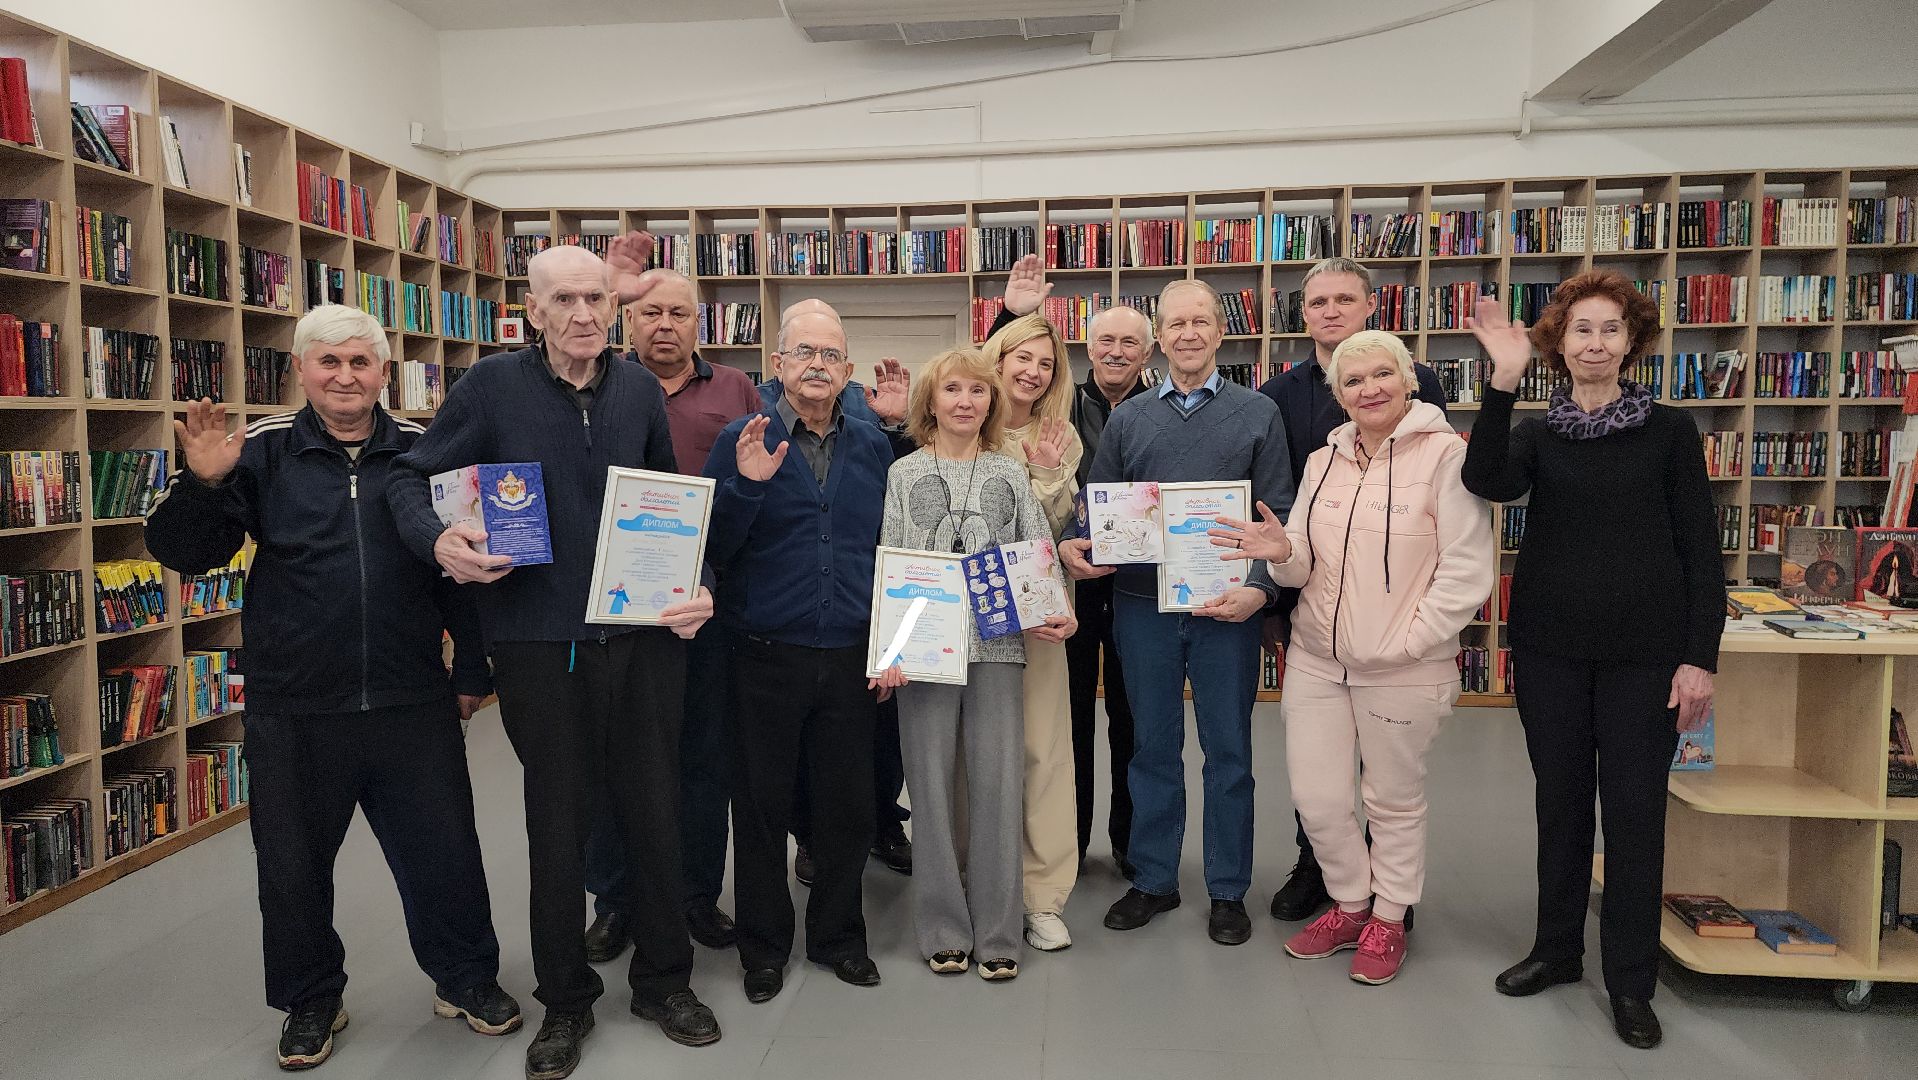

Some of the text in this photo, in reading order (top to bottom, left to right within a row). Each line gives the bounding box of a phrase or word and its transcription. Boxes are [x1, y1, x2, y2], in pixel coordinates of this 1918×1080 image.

[1366, 500, 1410, 515] HILFGER
[642, 519, 679, 528] ДИПЛОМ
[908, 588, 943, 596] ДИПЛОМ
